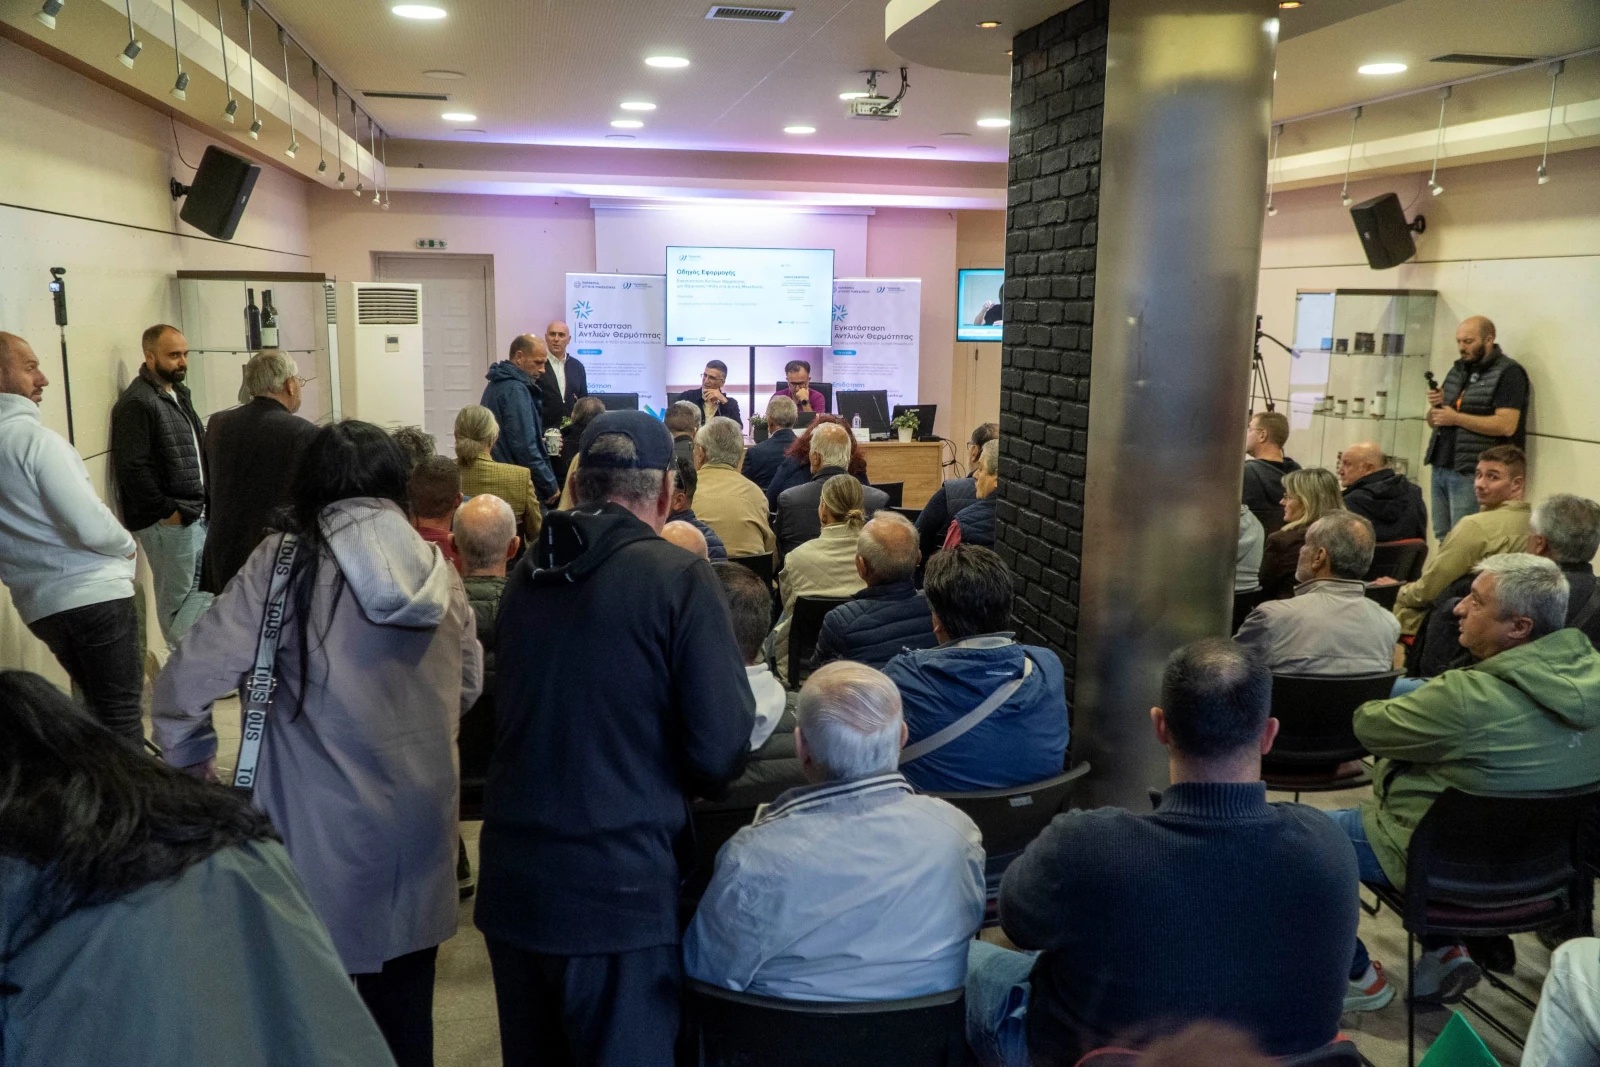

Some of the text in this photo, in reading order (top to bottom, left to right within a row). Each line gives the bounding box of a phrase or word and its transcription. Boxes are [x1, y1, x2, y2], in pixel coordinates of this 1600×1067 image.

[676, 268, 736, 277] Οδηγός Εφαρμογής
[578, 322, 632, 330] Εγκατάσταση
[834, 324, 886, 332] Εγκατάσταση
[578, 330, 662, 340] Αντλιών Θερμότητας
[834, 332, 914, 341] Αντλιών Θερμότητας
[276, 540, 297, 576] TOUS
[264, 601, 283, 640] TOUS
[252, 664, 272, 702] TOUS
[245, 712, 263, 741] OUS
[237, 766, 254, 785] TO
